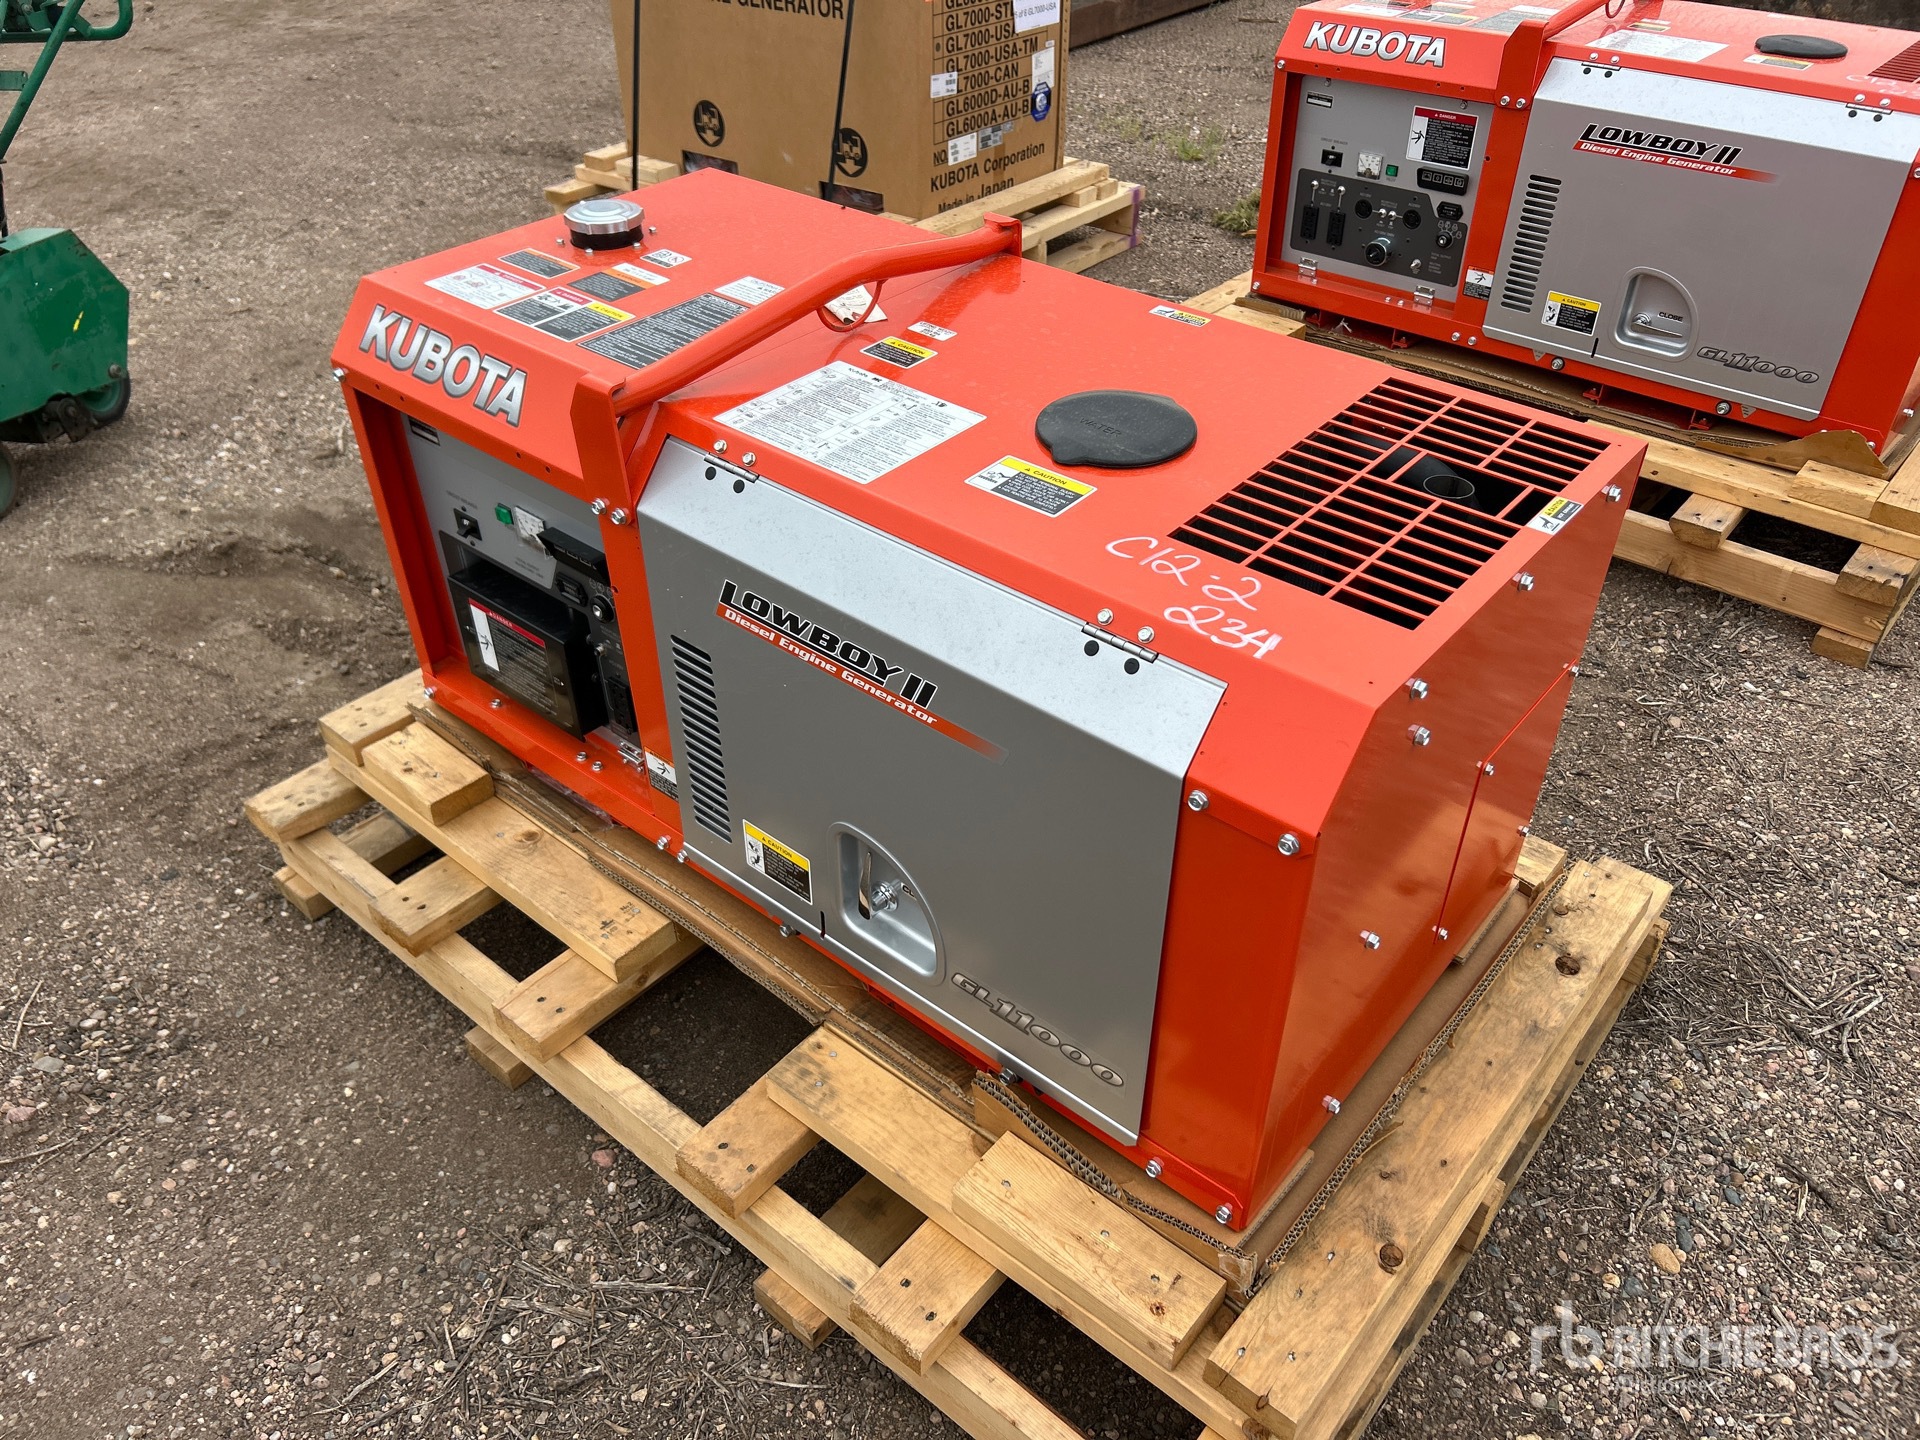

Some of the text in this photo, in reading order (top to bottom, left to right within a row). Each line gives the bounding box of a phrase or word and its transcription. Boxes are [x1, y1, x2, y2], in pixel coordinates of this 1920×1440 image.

[946, 36, 1038, 73] GL7000-USA-TM
[1303, 21, 1446, 68] KUBOTA
[957, 62, 1018, 94] L7000-CAN
[946, 79, 1030, 117] GL6000D-AU-B
[946, 98, 1029, 138] GL6000A-AU-B
[1579, 123, 1719, 161] LOWBOY
[1580, 143, 1736, 175] Diesel Engine Generator
[931, 163, 979, 192] KUBOTA
[984, 142, 1045, 174] Corporation
[1658, 311, 1683, 322] CLOSE
[358, 303, 528, 428] KUBOTA
[898, 343, 926, 355] CAUTION
[1697, 346, 1819, 383] GL11000
[1080, 417, 1122, 438] WATER
[1033, 470, 1067, 485] CAUTION
[719, 579, 904, 684] LOWBOY
[724, 608, 938, 725] Diesel Engine Generator
[767, 840, 793, 859] CAUTION
[951, 972, 1124, 1087] GL11000
